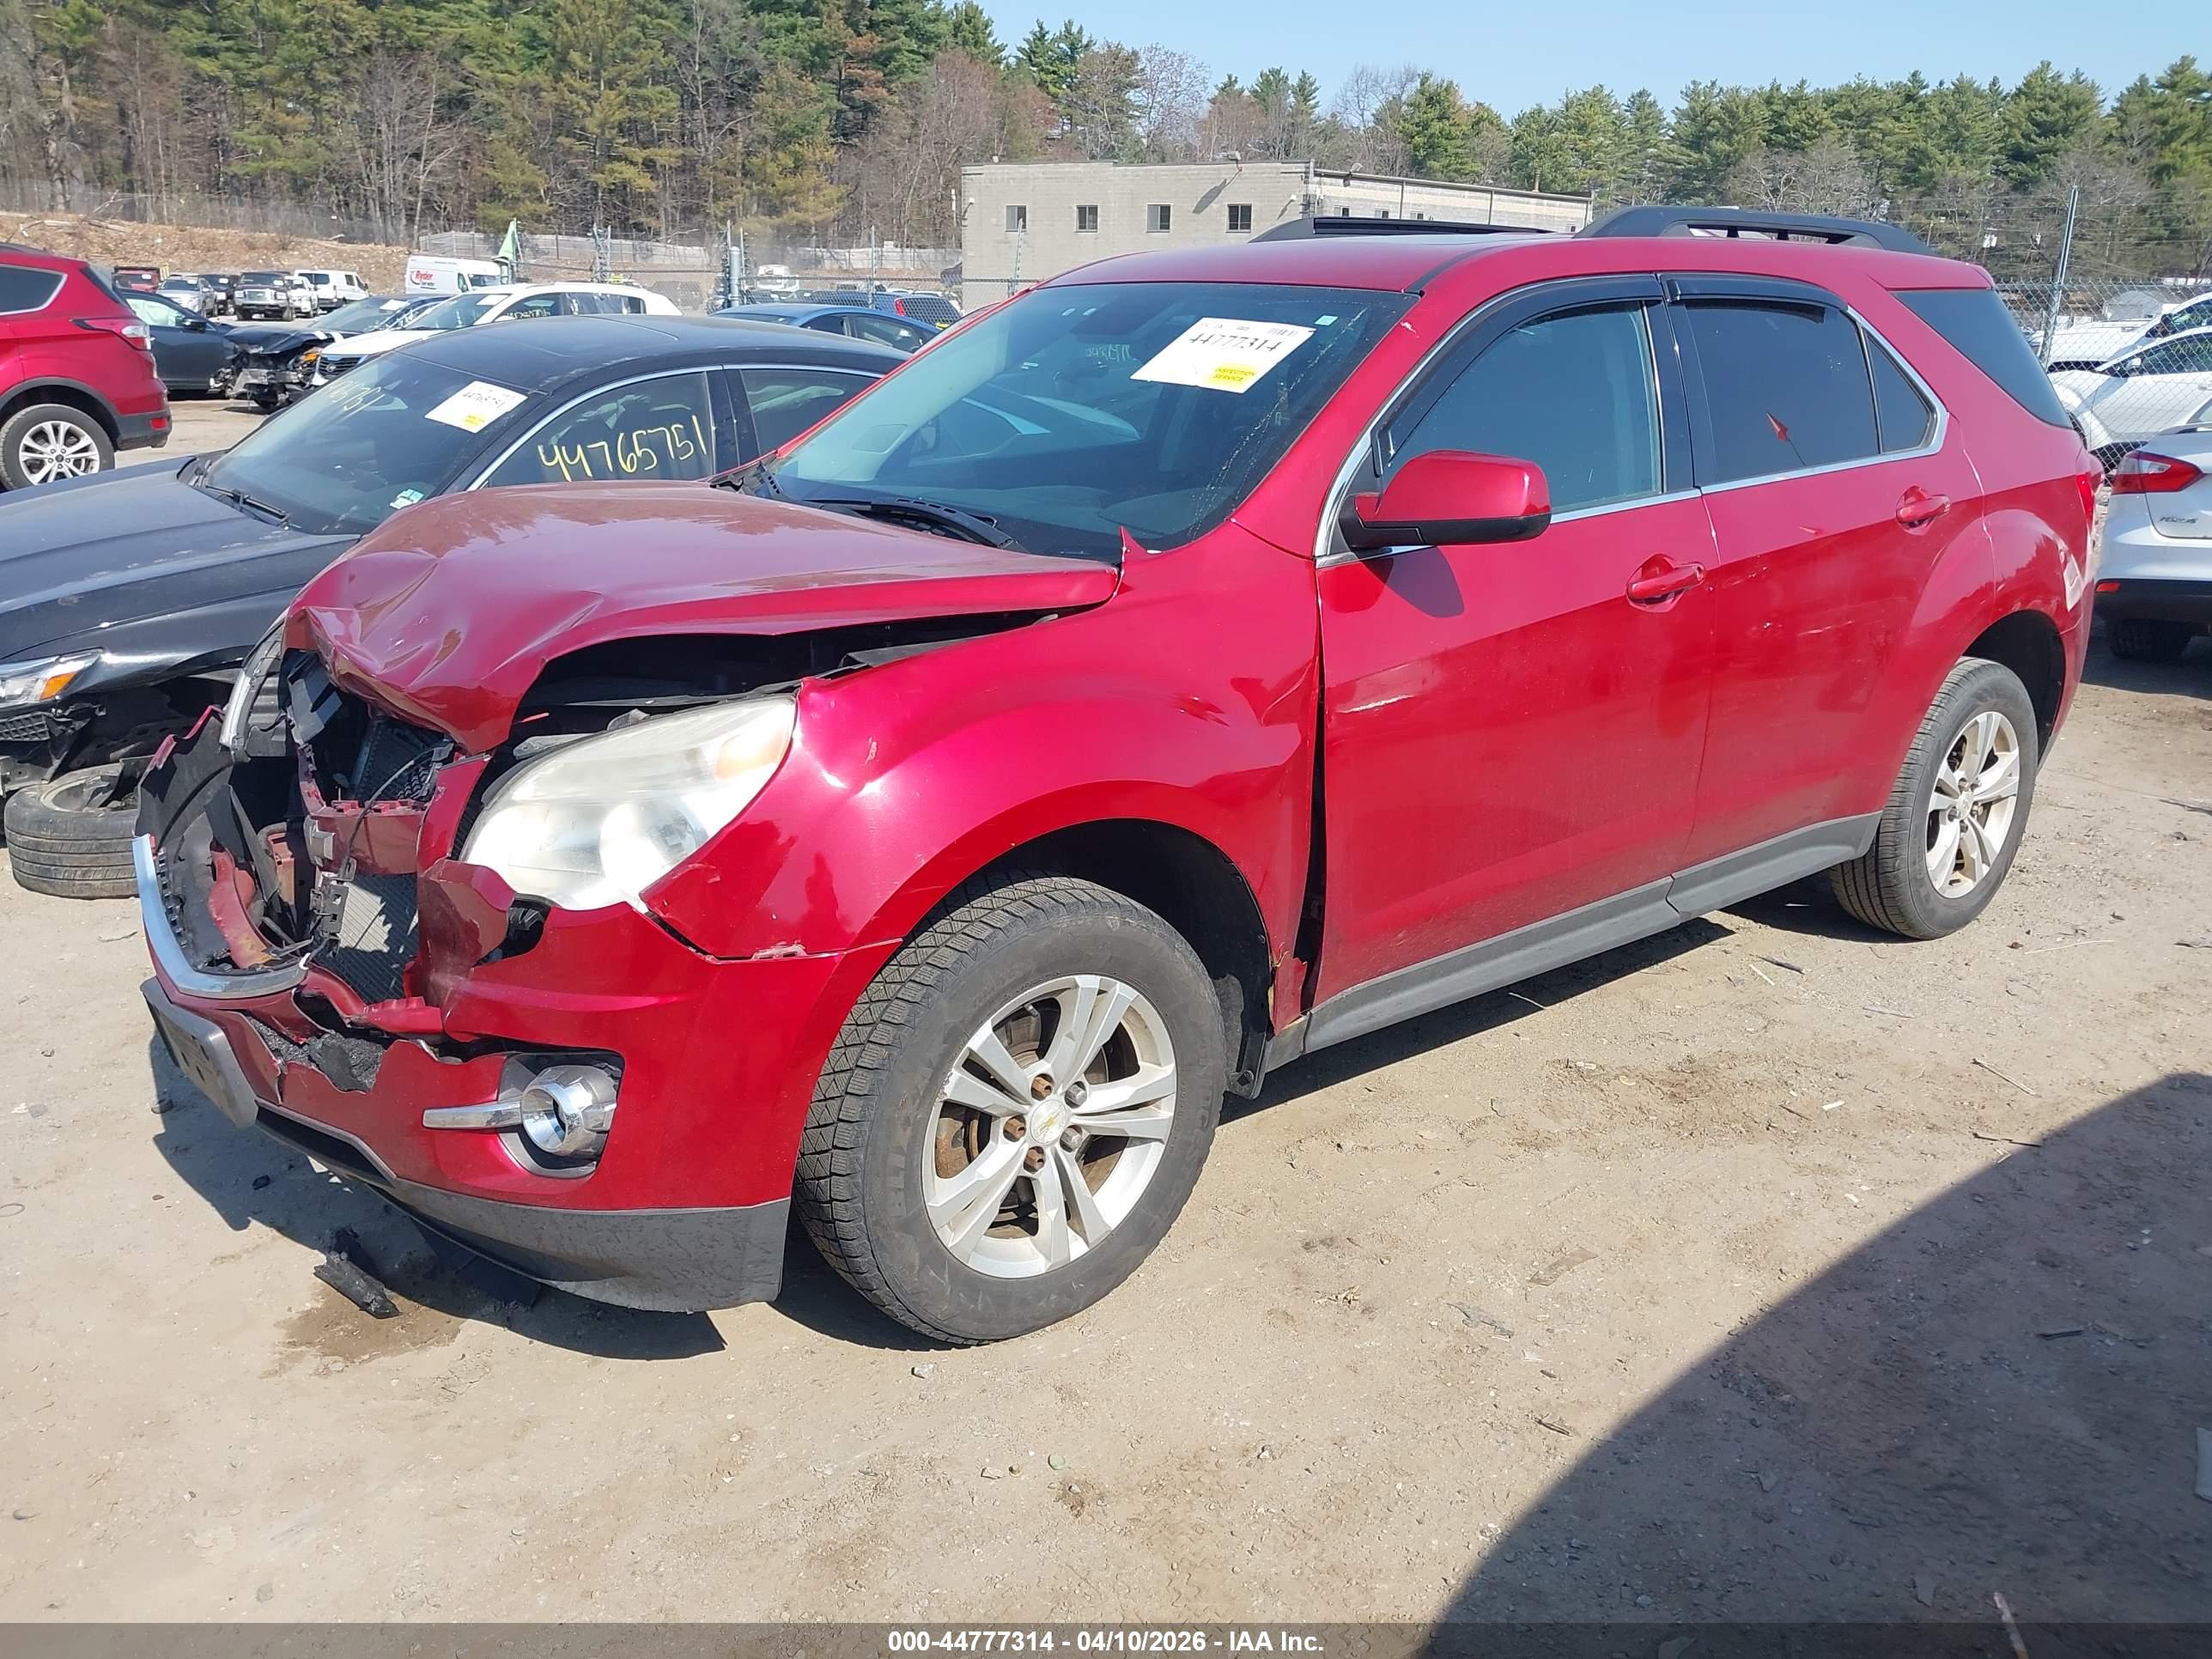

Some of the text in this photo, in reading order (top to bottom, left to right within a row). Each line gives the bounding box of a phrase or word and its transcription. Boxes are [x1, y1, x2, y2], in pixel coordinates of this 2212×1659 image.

[416, 270, 434, 282] Ryder
[1189, 332, 1283, 352] 44777314
[538, 415, 708, 483] 44765751
